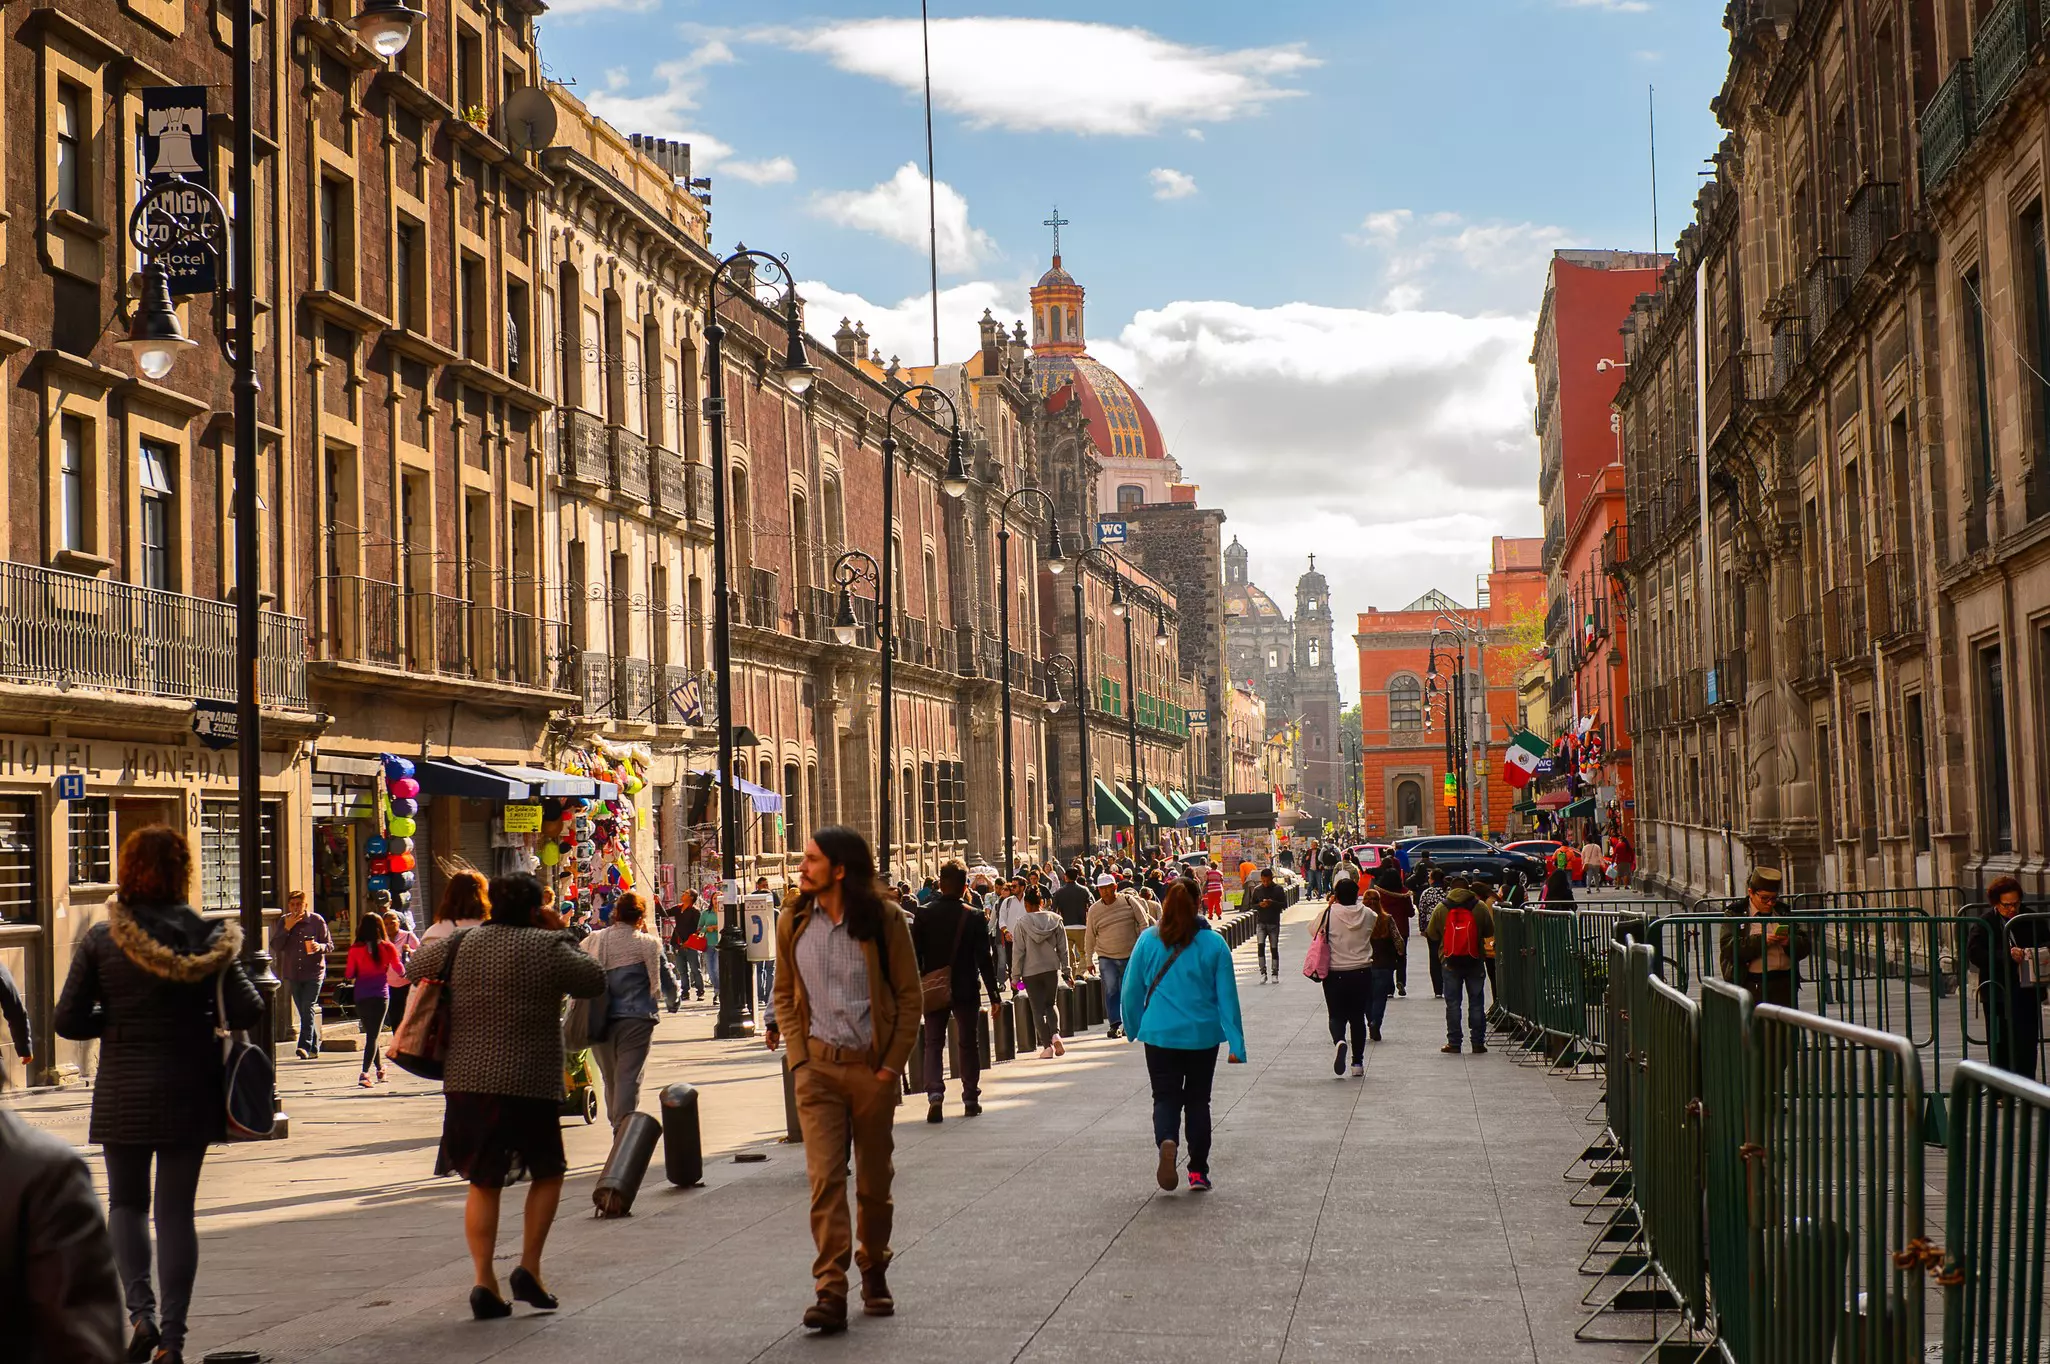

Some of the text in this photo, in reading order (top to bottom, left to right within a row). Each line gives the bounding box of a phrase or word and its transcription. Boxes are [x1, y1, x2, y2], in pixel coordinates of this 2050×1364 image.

[157, 252, 205, 265] Hotel
[1101, 523, 1123, 535] WC
[670, 681, 699, 712] WC
[214, 711, 238, 725] AMIG
[1188, 711, 1206, 720] WC
[213, 723, 239, 735] ZOCAL
[0, 739, 230, 785] HOTEL MONEDA
[64, 777, 80, 797] H
[189, 792, 198, 828] 8
